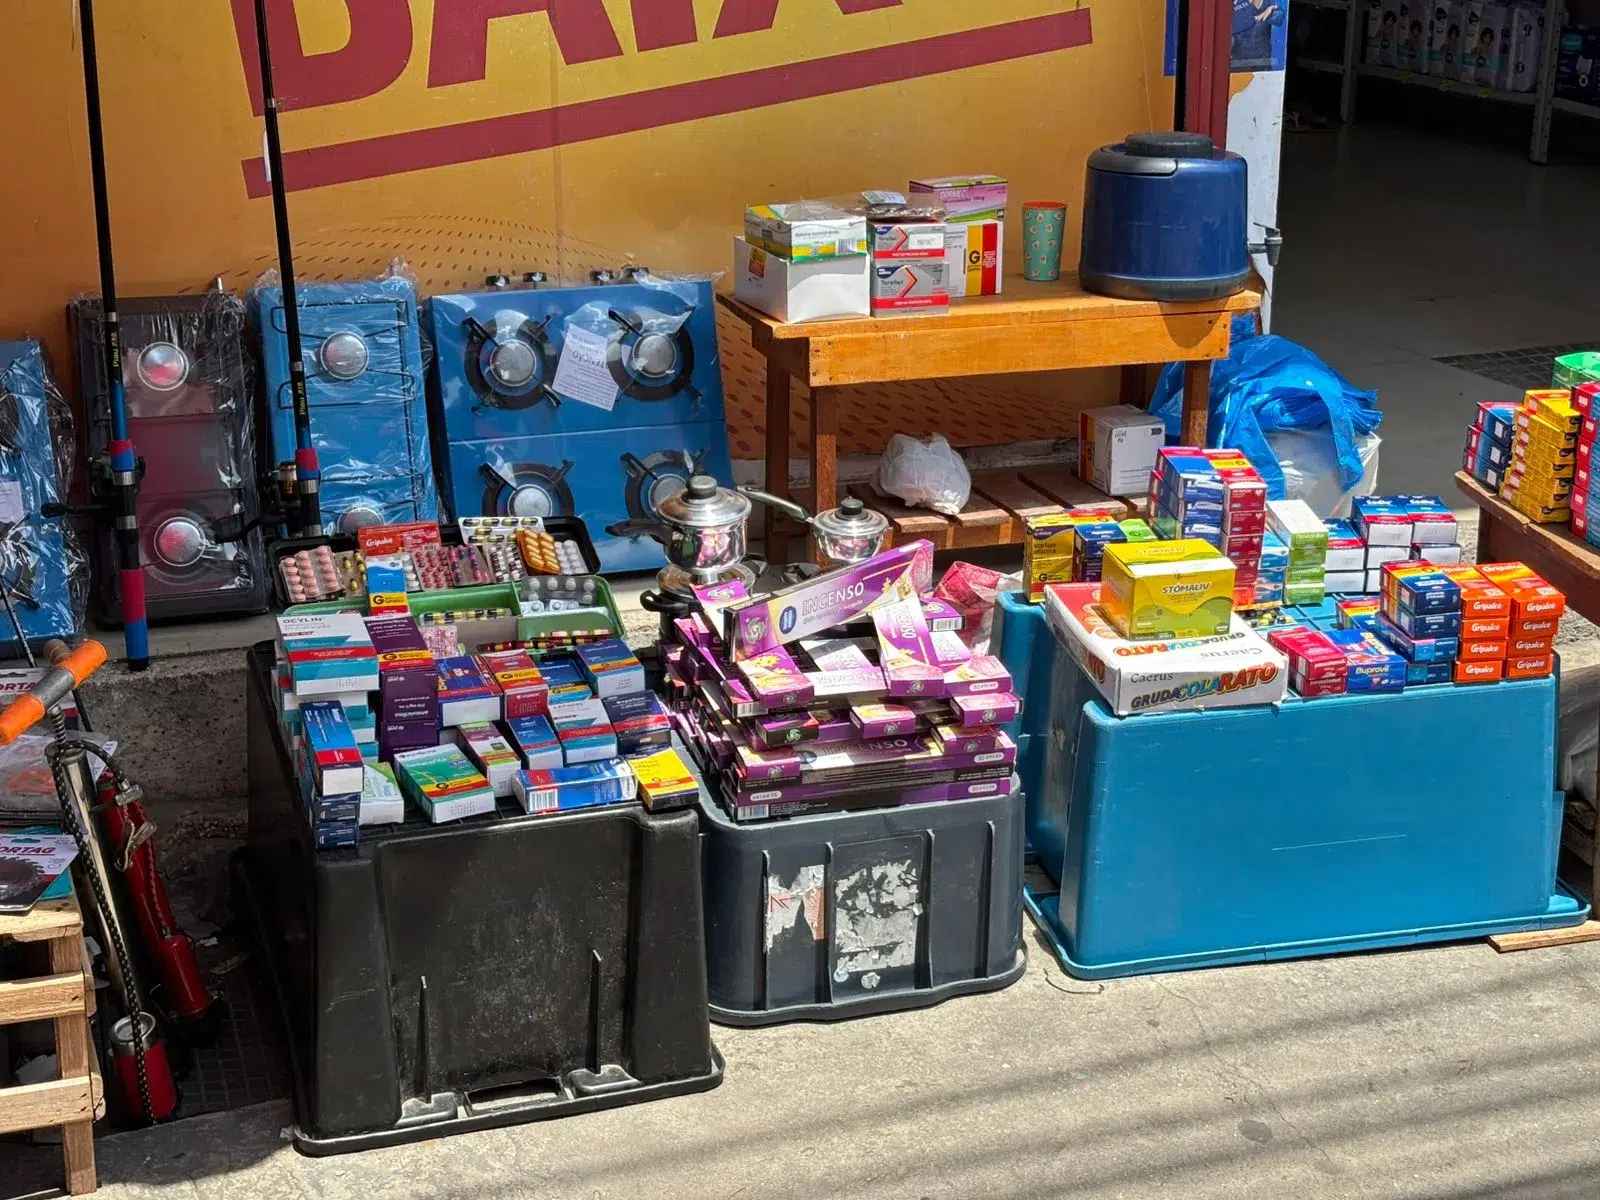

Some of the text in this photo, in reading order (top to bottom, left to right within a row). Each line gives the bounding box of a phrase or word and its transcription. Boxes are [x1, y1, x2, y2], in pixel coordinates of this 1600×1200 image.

[969, 250, 981, 265] G
[1039, 573, 1048, 582] G
[373, 595, 385, 606] G
[801, 581, 865, 617] INCENSO
[1473, 601, 1503, 611] Gripalce
[1526, 602, 1556, 612] Gripalce
[1471, 622, 1501, 633] Gripalce
[1523, 621, 1552, 631] Gripalce
[1470, 644, 1499, 654] Gripalce
[1516, 640, 1545, 650] Gripalce
[1355, 664, 1389, 675] Buprovil
[1465, 665, 1494, 675] Gripalce
[1517, 660, 1545, 670] Gripalce
[1130, 672, 1174, 684] Caerus
[1131, 661, 1279, 709] GRUDACOLARATO
